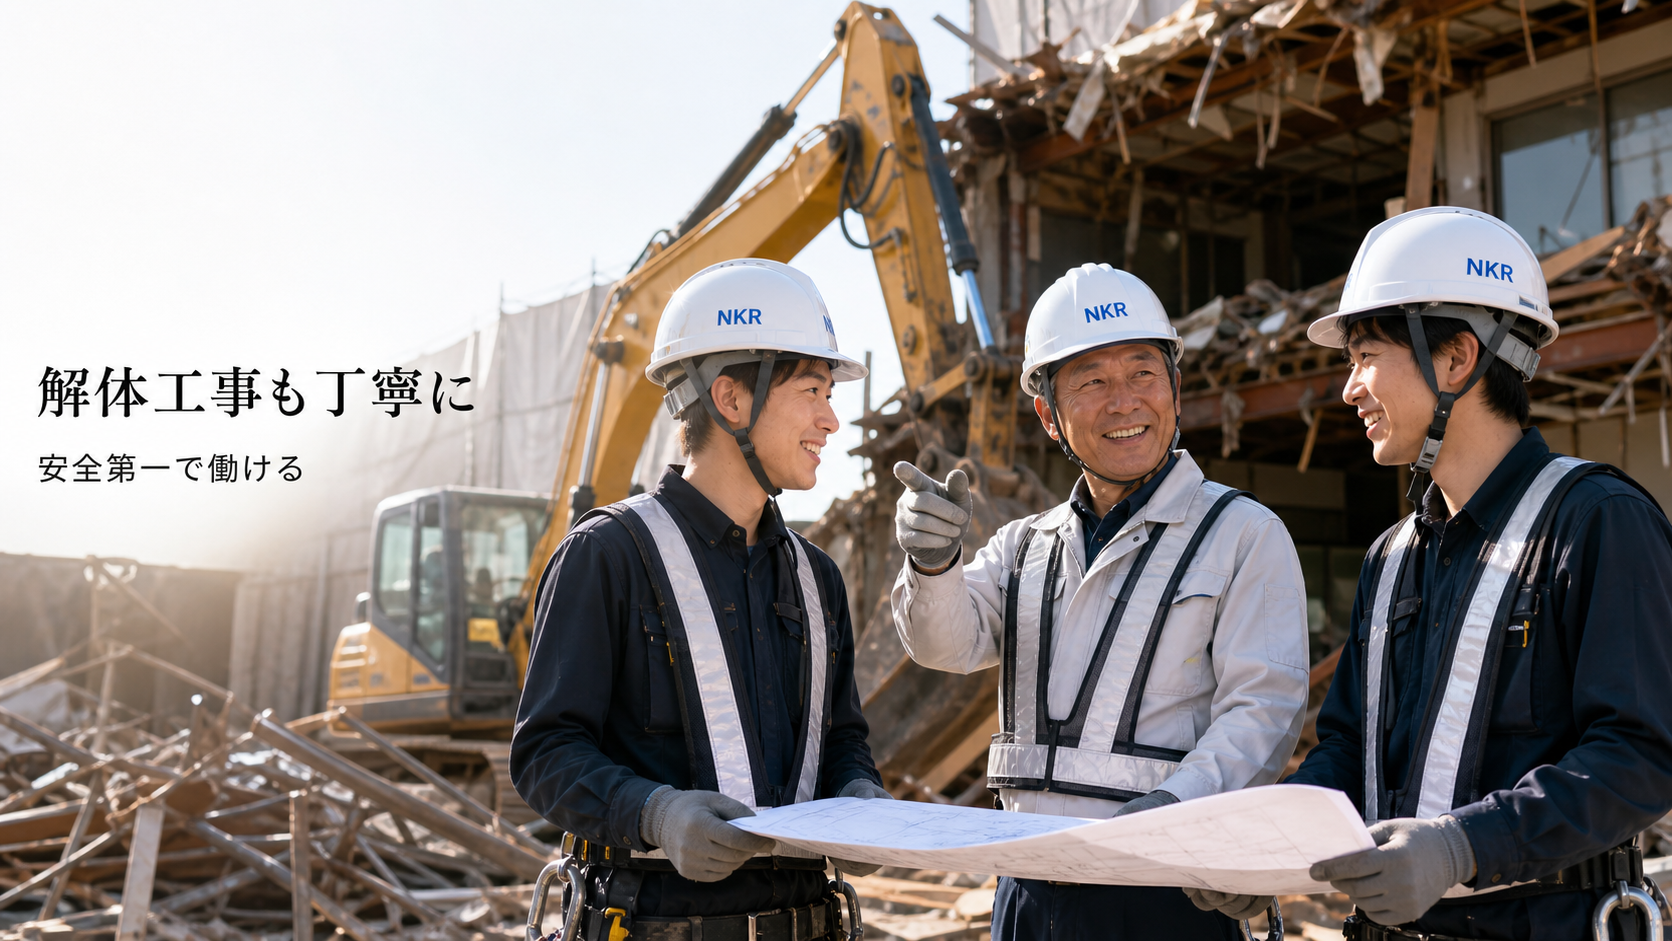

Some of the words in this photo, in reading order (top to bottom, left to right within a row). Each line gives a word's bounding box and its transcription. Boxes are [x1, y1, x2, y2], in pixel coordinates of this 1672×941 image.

[1466, 257, 1514, 284] NKR
[717, 308, 762, 326] NKR
[1084, 301, 1129, 324] NKR
